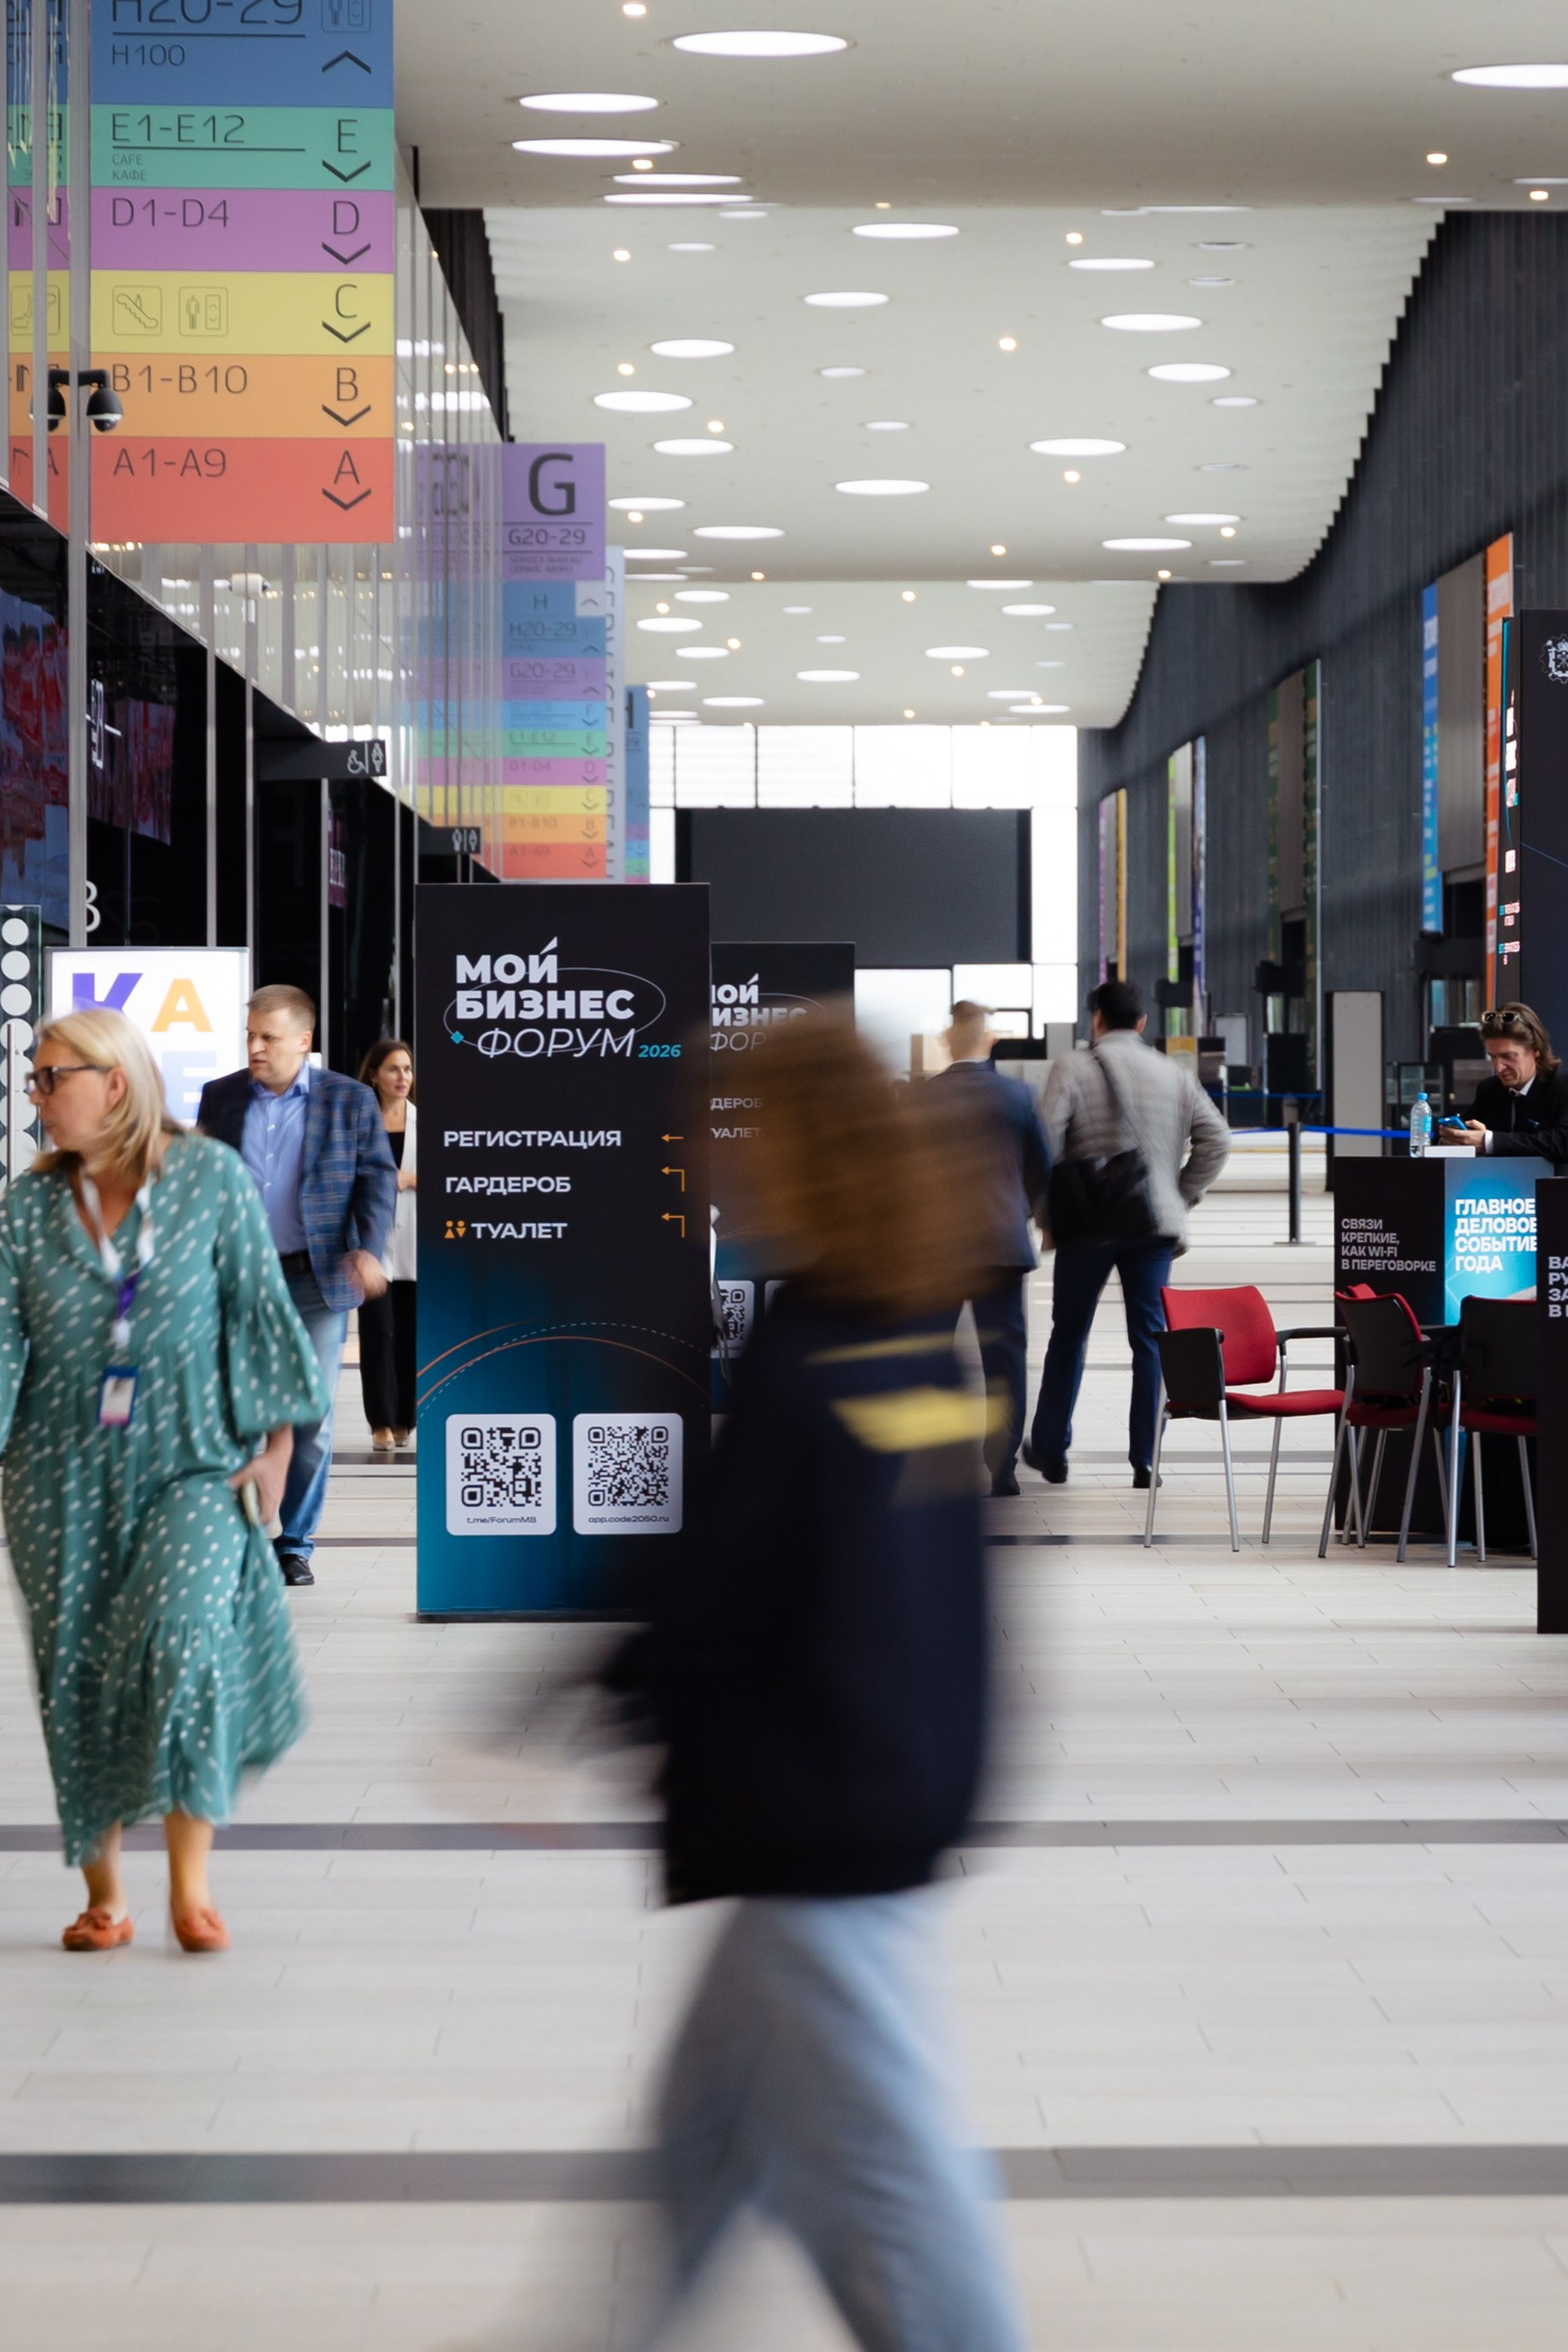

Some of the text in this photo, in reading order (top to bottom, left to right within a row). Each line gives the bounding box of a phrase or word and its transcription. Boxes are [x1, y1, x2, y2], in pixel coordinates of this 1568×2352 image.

[111, 44, 185, 66] H100
[111, 113, 245, 143] E1-E12
[337, 119, 358, 153] E
[111, 154, 143, 166] CAFE
[111, 169, 147, 181] КАФЕ
[112, 198, 229, 227] D1-D4
[334, 201, 360, 235] D
[335, 284, 358, 319] C
[112, 364, 248, 394] B1-B10
[337, 368, 359, 402] B
[113, 448, 227, 477] A1-A9
[334, 451, 360, 485] A
[529, 452, 576, 516] G
[508, 528, 586, 545] G20-29
[533, 594, 548, 610] H
[456, 936, 558, 984] МОЙ
[456, 989, 635, 1020] БИЗНЕС
[477, 1028, 682, 1058] ФОРУМ 2026
[443, 1130, 622, 1149] РЕГИСТРАЦИЯ
[445, 1177, 571, 1195] ГАРДЕРОБ
[1455, 1198, 1536, 1215] ГЛАВНОЕ
[470, 1223, 568, 1239] ТУАЛЕТ
[1341, 1218, 1383, 1230] СВЯЗИ
[1455, 1217, 1537, 1237] ДЕЛОВОЕ
[1341, 1232, 1400, 1245] КРЕПКИЕ,
[1455, 1235, 1537, 1253] СОБЫТИЕ
[1341, 1245, 1398, 1257] КАК WI-FI
[1341, 1259, 1437, 1272] В ПЕРЕГОВОРКЕ
[1455, 1255, 1504, 1274] ГОДА
[1548, 1304, 1562, 1317] В
